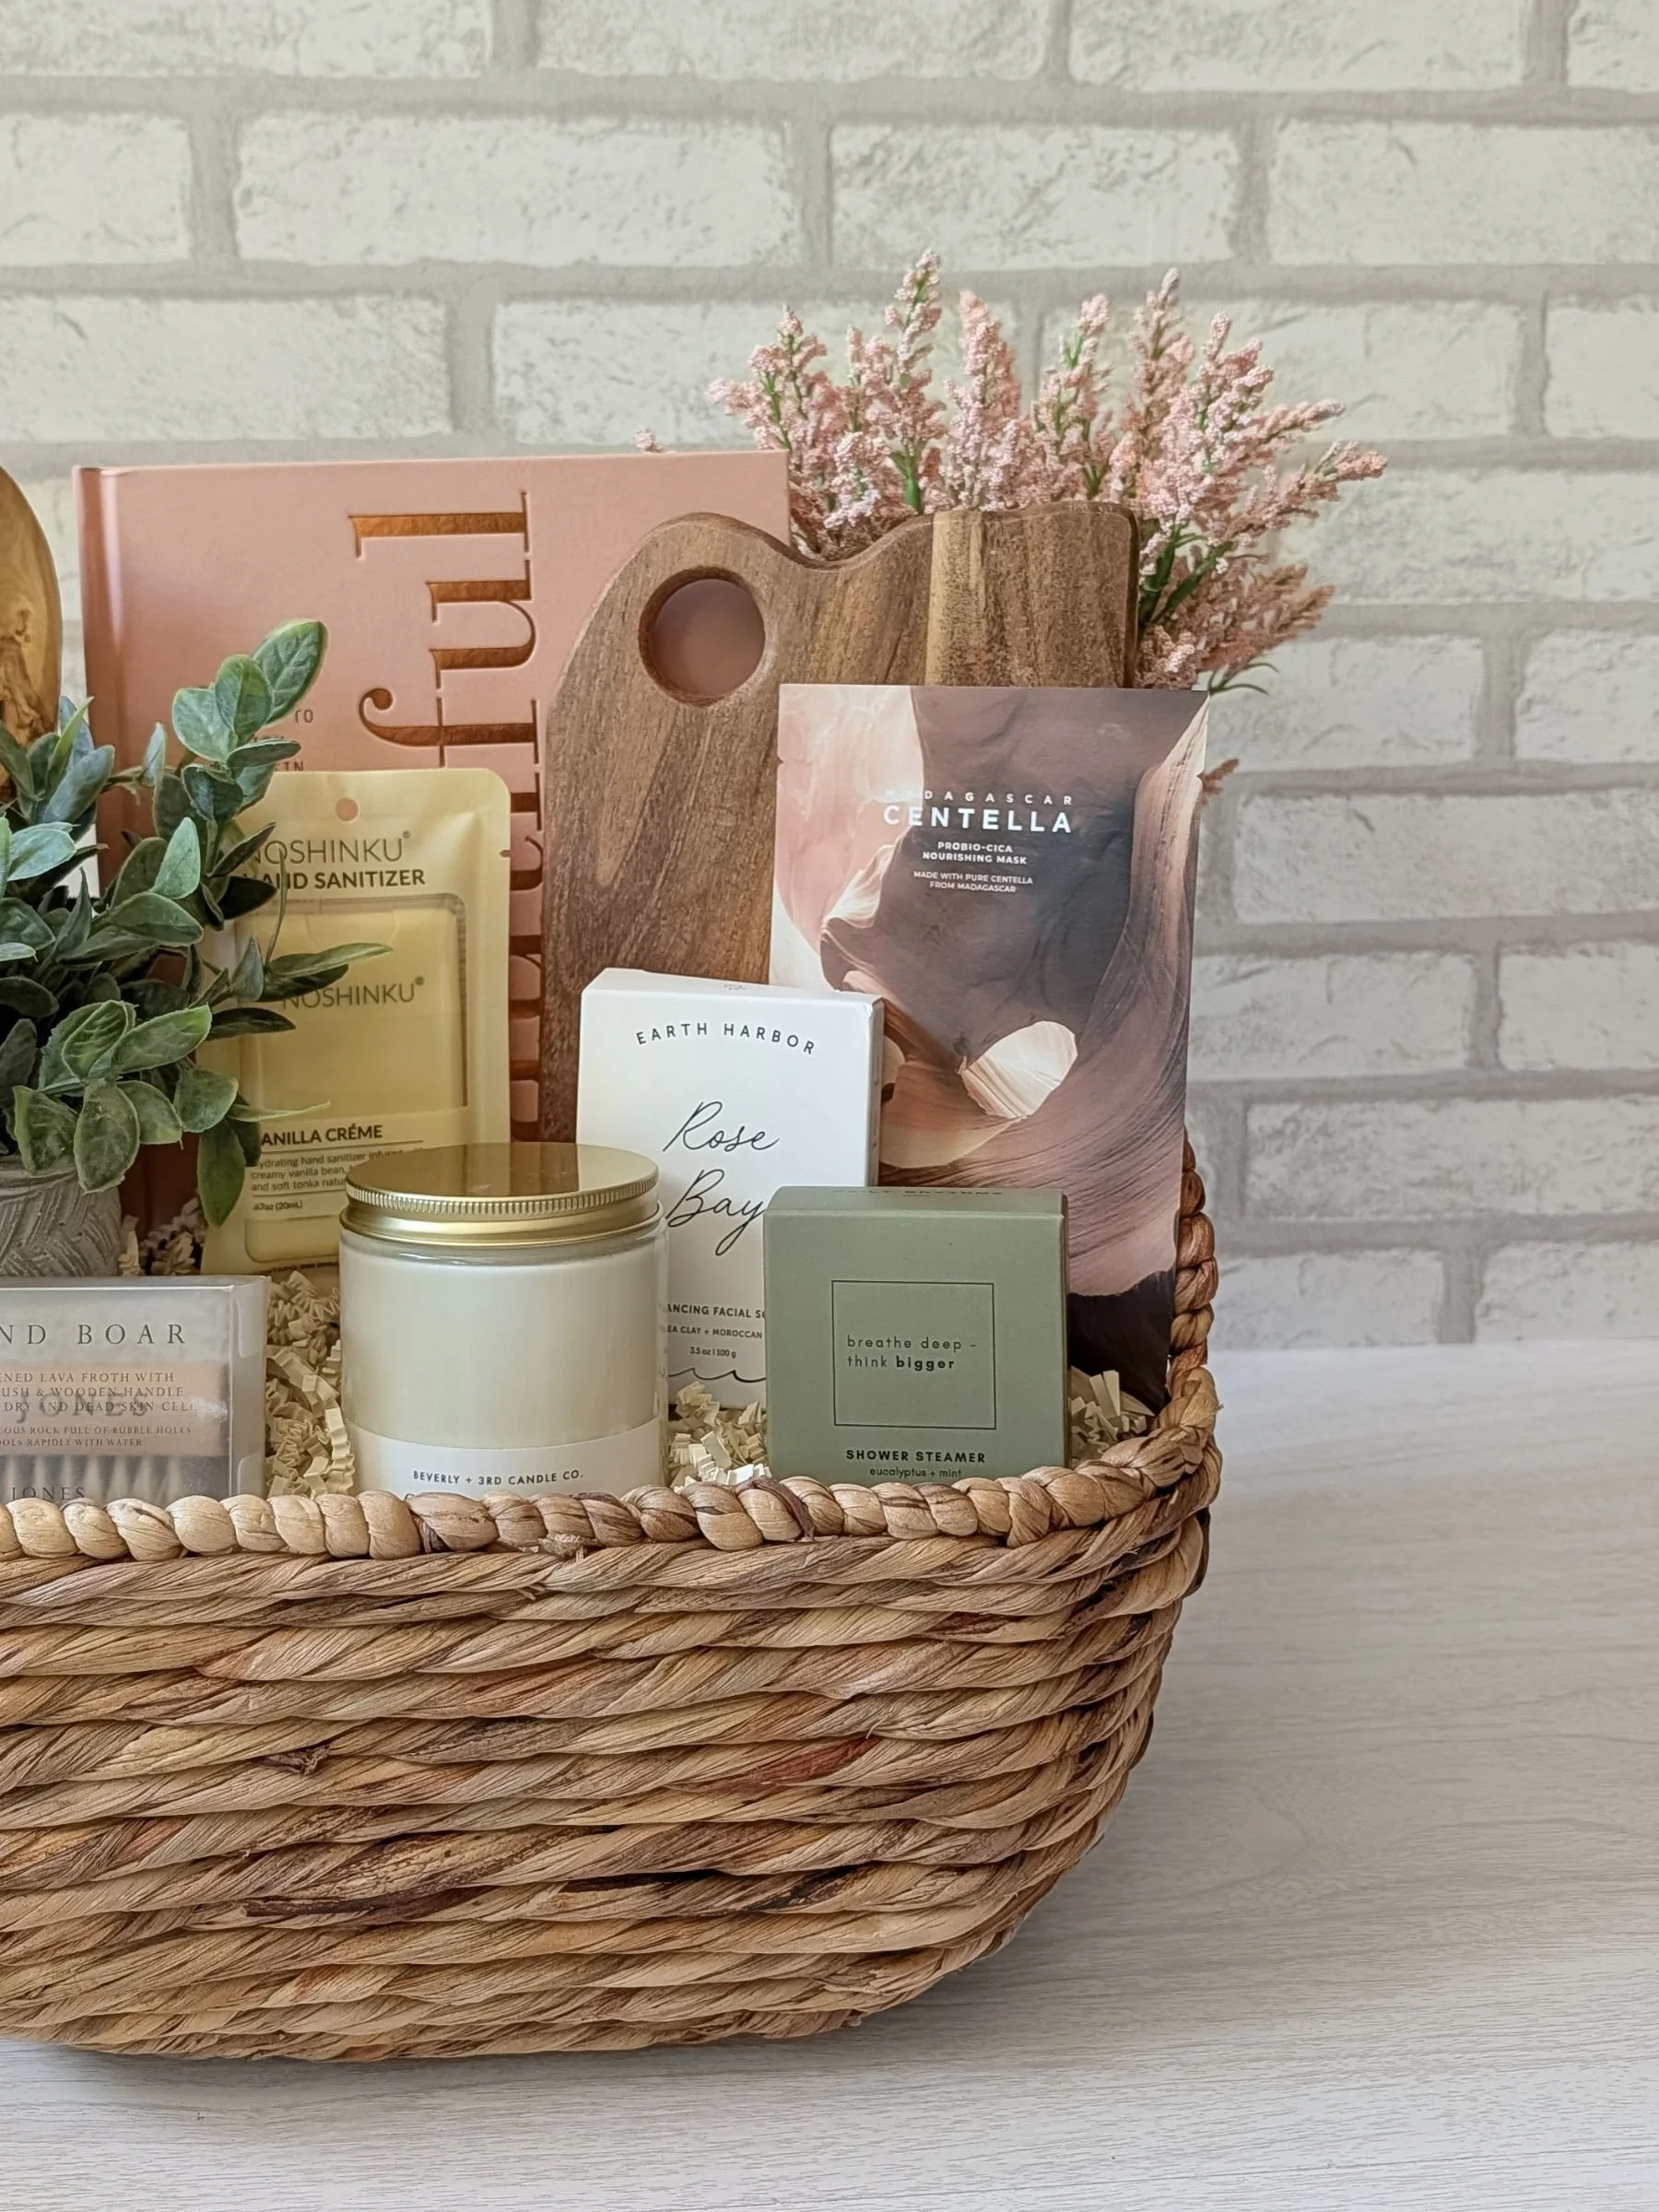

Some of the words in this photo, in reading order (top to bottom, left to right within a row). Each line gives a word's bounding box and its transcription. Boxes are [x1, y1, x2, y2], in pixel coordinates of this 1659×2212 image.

[886, 790, 1072, 806] DAGASCAR
[883, 805, 1072, 833] CENTELLA
[937, 841, 1013, 853] PROBIO-CICA
[923, 851, 993, 864] NOURISHING
[996, 855, 1028, 865] MASK
[314, 868, 426, 889] SANITIZER
[913, 870, 938, 879] MADE
[940, 873, 963, 881] WITH
[965, 874, 989, 882] PURE
[991, 876, 1033, 885] CENTELLA
[929, 881, 955, 889] FROM
[957, 883, 1017, 893] MADAGASCAR
[636, 1022, 708, 1045] EARTH
[724, 1023, 815, 1054] HARBOR
[662, 1101, 780, 1152] Rose
[262, 1129, 322, 1147] ANILLA
[259, 1155, 300, 1169] ydrating
[301, 1154, 324, 1165] hand
[327, 1151, 367, 1163] sanitizer
[251, 1171, 286, 1181] creamy
[288, 1167, 319, 1177] vanilla
[252, 1182, 269, 1192] and
[272, 1180, 290, 1190] soft
[293, 1178, 320, 1188] tonka
[323, 1176, 346, 1187] natu
[665, 1169, 766, 1256] Bay
[713, 1307, 751, 1318] FACIAL
[77, 1324, 186, 1345] BOAR
[680, 1326, 701, 1335] CLAY
[712, 1328, 763, 1339] MOROCCAN
[847, 1335, 912, 1348] breathe
[921, 1336, 961, 1353] deep
[847, 1355, 888, 1368] think
[896, 1356, 955, 1371] bigger
[41, 1373, 75, 1382] LAVA
[81, 1373, 130, 1382] FROTH
[135, 1372, 174, 1382] WITH
[51, 1387, 118, 1398] WOODEN
[124, 1387, 184, 1397] HANDLE
[5, 1402, 31, 1412] DRY
[39, 1402, 69, 1412] AND
[76, 1402, 116, 1412] DEAD
[122, 1401, 155, 1412] SKIN
[161, 1402, 197, 1412] CELL
[29, 1426, 60, 1435] ROCK
[64, 1426, 90, 1434] FULL
[94, 1426, 109, 1435] OF
[112, 1426, 153, 1435] BUBBLE
[156, 1426, 193, 1435] HOLES
[27, 1438, 71, 1447] RAPIDLY
[75, 1438, 104, 1447] WITH
[107, 1438, 143, 1447] WATER
[846, 1449, 910, 1462] SHOWER
[915, 1452, 986, 1464] STEAMER
[413, 1470, 460, 1485] BEVERLY
[478, 1477, 502, 1486] 3RD
[509, 1473, 557, 1485] CANDLE
[562, 1469, 583, 1480] CO.
[869, 1467, 927, 1479] eucalyptus
[939, 1468, 962, 1478] mint
